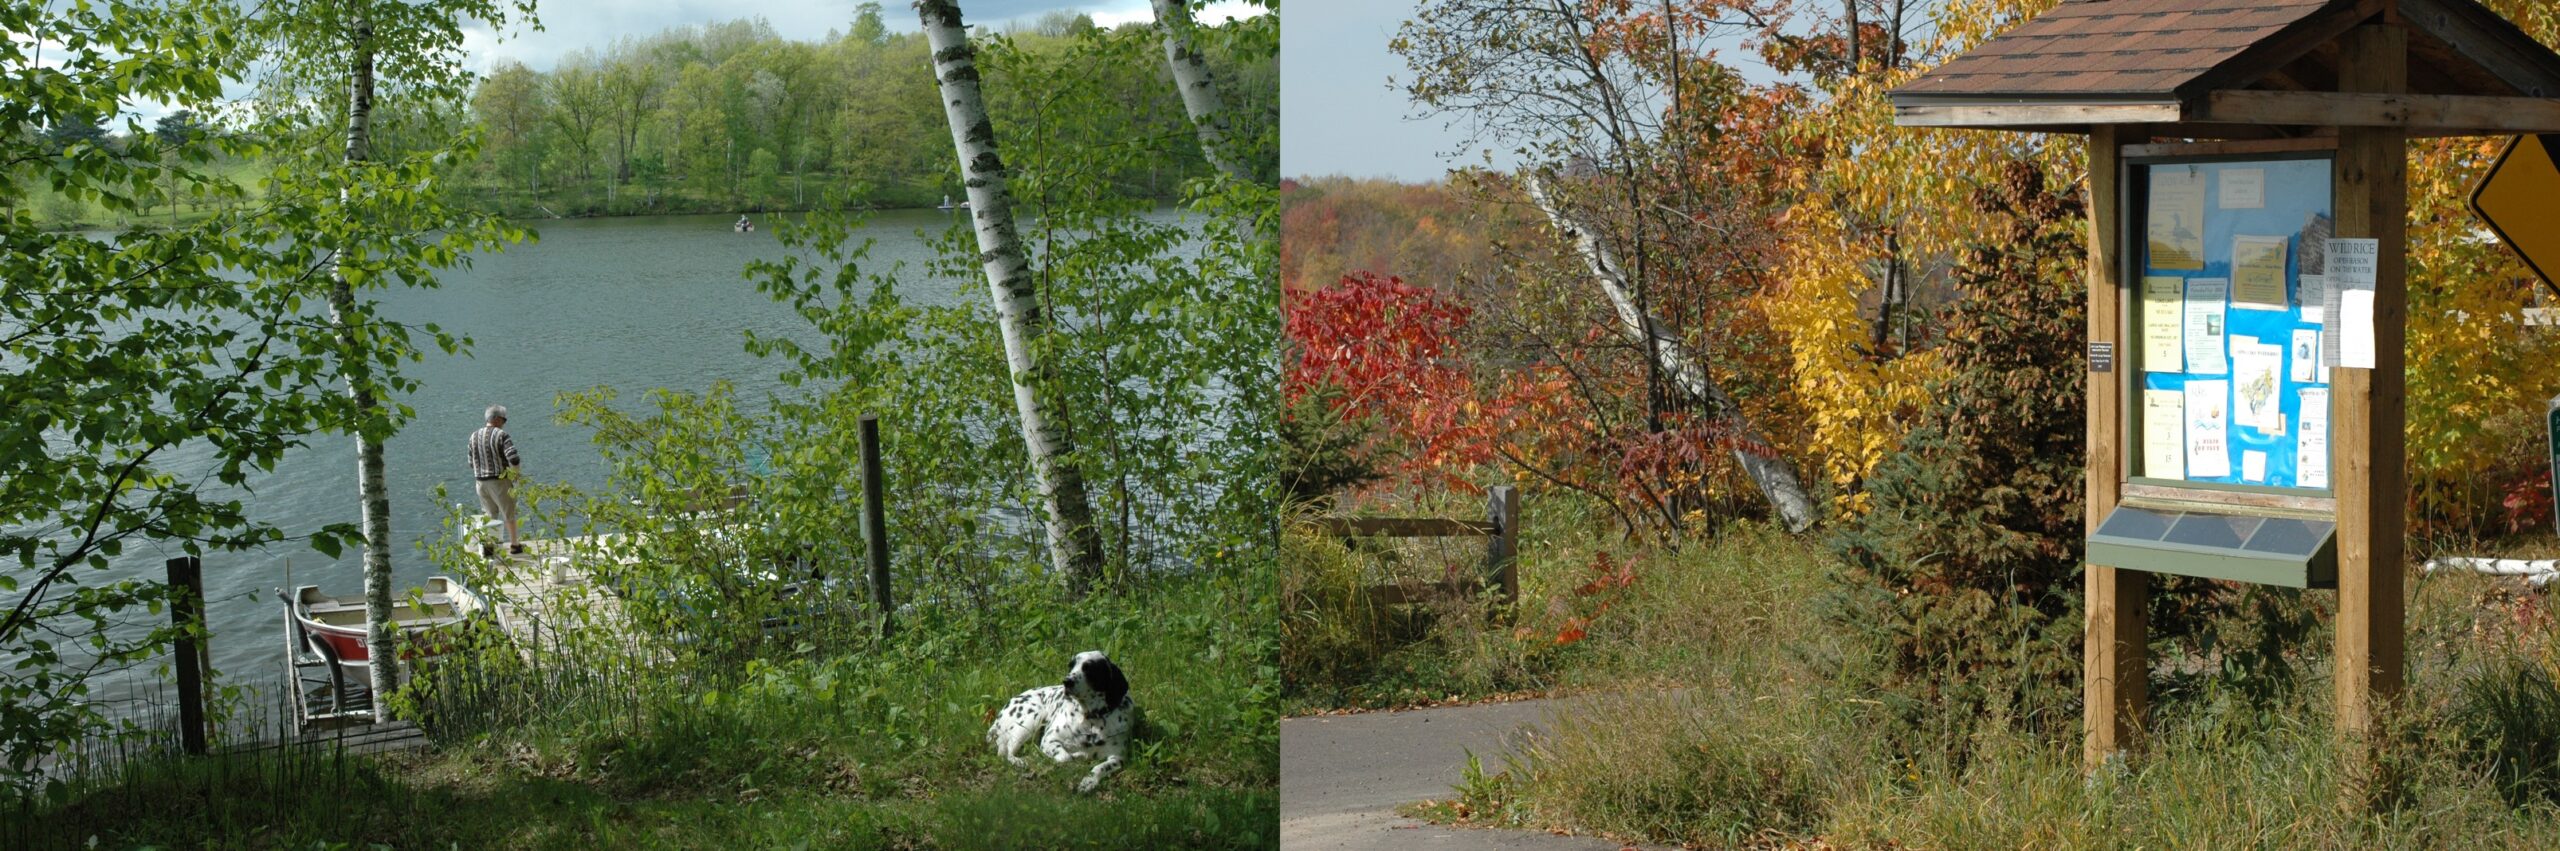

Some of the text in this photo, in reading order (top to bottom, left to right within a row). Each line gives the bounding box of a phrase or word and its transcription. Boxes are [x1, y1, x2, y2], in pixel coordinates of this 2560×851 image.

[2328, 242, 2375, 255] WILD RICE
[2329, 265, 2341, 273] ON
